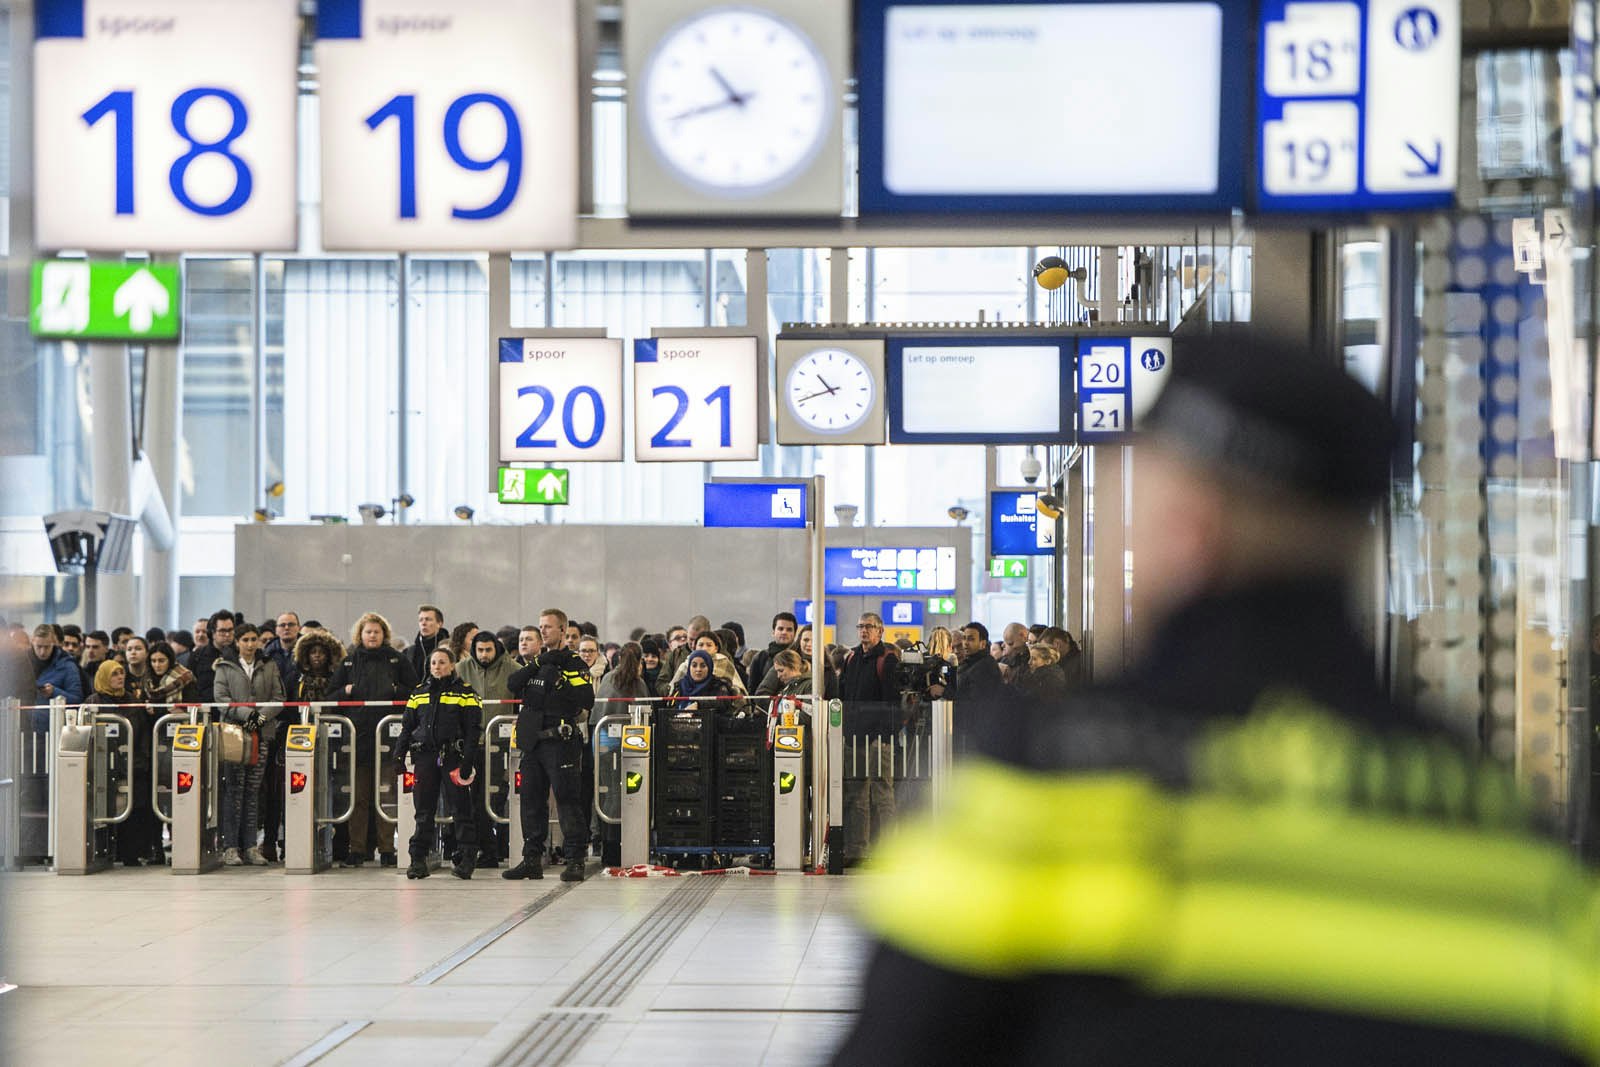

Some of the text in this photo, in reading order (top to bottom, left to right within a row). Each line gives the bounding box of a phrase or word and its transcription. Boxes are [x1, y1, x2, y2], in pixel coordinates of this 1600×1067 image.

[1285, 39, 1333, 82] 18
[81, 87, 253, 217] 18
[364, 92, 523, 220] 19
[1283, 138, 1331, 182] 19
[528, 350, 566, 360] spoor
[663, 349, 701, 359] spoor
[908, 354, 976, 365] Let op omroep
[1090, 363, 1120, 383] 20
[515, 385, 606, 449] 20
[651, 385, 732, 448] 21
[1091, 409, 1119, 428] 21
